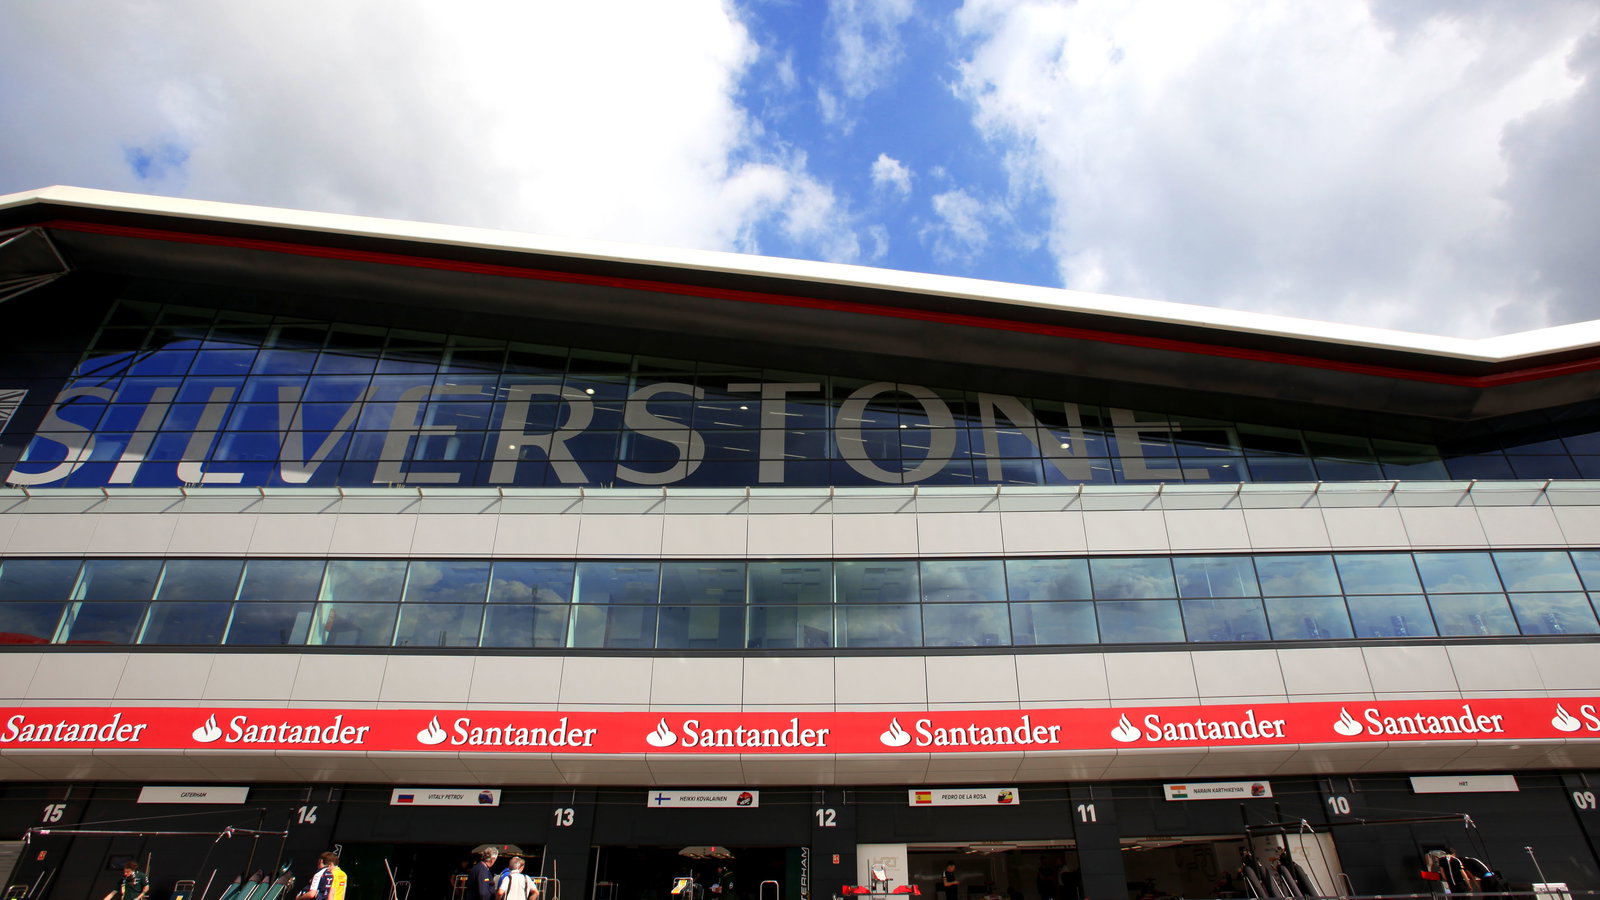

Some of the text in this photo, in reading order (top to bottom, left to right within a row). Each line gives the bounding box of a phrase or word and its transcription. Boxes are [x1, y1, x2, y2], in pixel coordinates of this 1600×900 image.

[6, 380, 1210, 486] SILVERSTONE
[0, 712, 148, 743] Santander
[224, 714, 370, 745] Santander
[450, 716, 597, 747] Santander
[914, 715, 1061, 747] Santander
[1143, 709, 1286, 741] Santander
[1362, 704, 1505, 735] Santander
[681, 717, 830, 748] Santander
[1212, 786, 1244, 794] KARTHIKEYAN
[1573, 791, 1596, 810] 09
[42, 804, 67, 823] 15
[298, 806, 318, 824] 14
[554, 809, 575, 827] 13
[815, 808, 837, 827] 12
[1077, 804, 1097, 823] 11
[1328, 796, 1350, 815] 10
